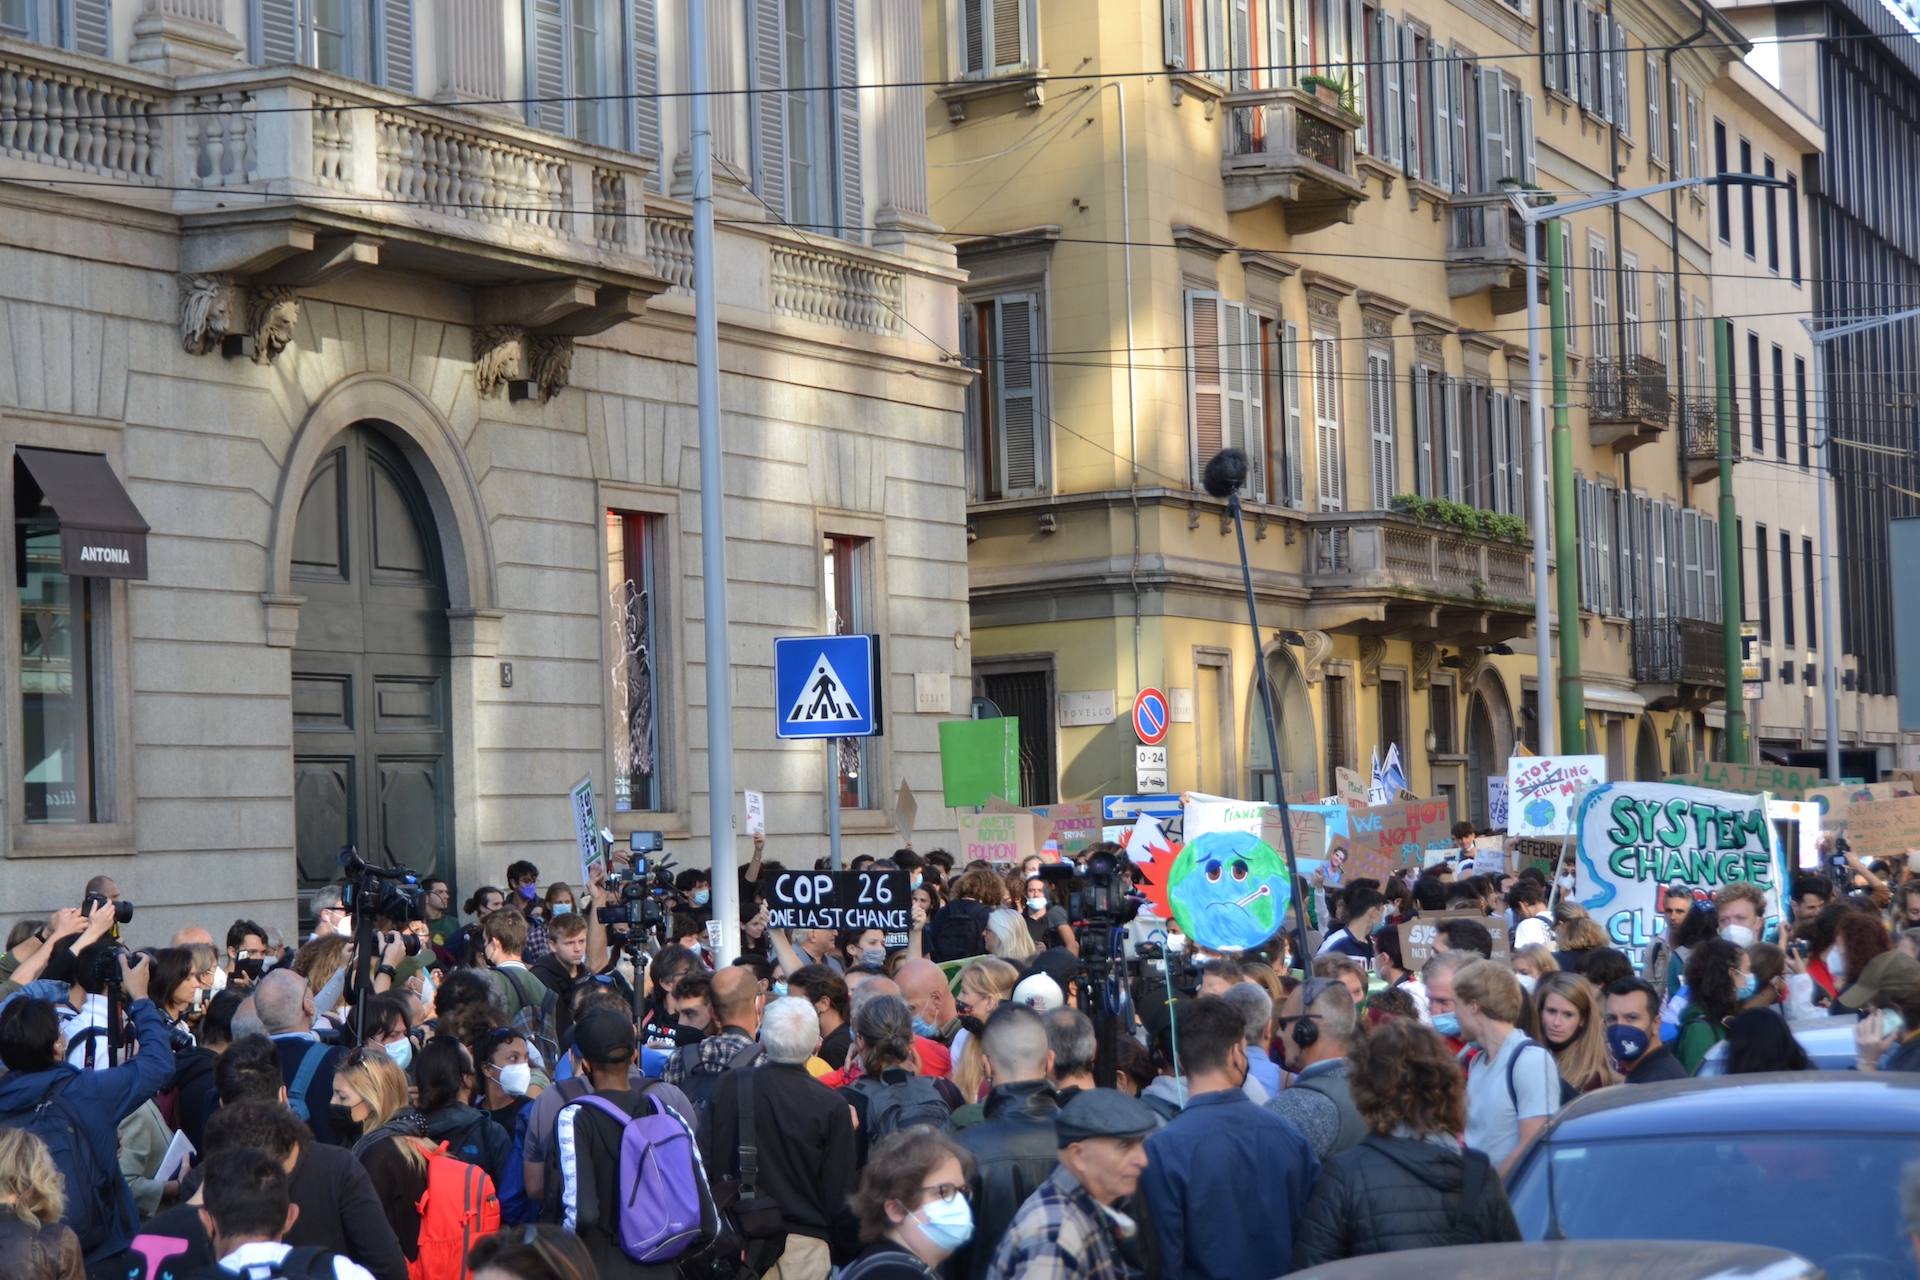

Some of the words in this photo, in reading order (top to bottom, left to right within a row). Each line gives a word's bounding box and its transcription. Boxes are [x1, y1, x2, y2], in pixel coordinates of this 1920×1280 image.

[81, 546, 130, 564] ANTONIA
[1063, 707, 1111, 718] ROVELLO
[1139, 752, 1146, 763] 0
[1152, 752, 1164, 763] 24
[1515, 760, 1552, 788] STOP
[1703, 765, 1730, 784] LA
[1738, 766, 1817, 791] TERRA
[1534, 783, 1557, 799] KILL
[1848, 800, 1902, 817] NUTRIRE
[1907, 799, 1917, 809] IL
[961, 815, 974, 829] CI
[980, 815, 1016, 829] AVETE
[1351, 812, 1384, 834] WE
[1405, 801, 1449, 826] HOT
[1607, 796, 1770, 851] SYSTEM
[1894, 814, 1905, 825] X
[1063, 830, 1085, 839] TRYING
[1379, 825, 1421, 847] NOT
[968, 843, 1017, 859] POLMONI
[1608, 846, 1775, 891] CHANGE
[775, 873, 833, 904] COP
[858, 873, 892, 904] 26
[769, 908, 797, 927] ONE
[800, 907, 843, 928] LAST
[845, 908, 907, 928] CHANCE
[1412, 948, 1427, 958] NOT
